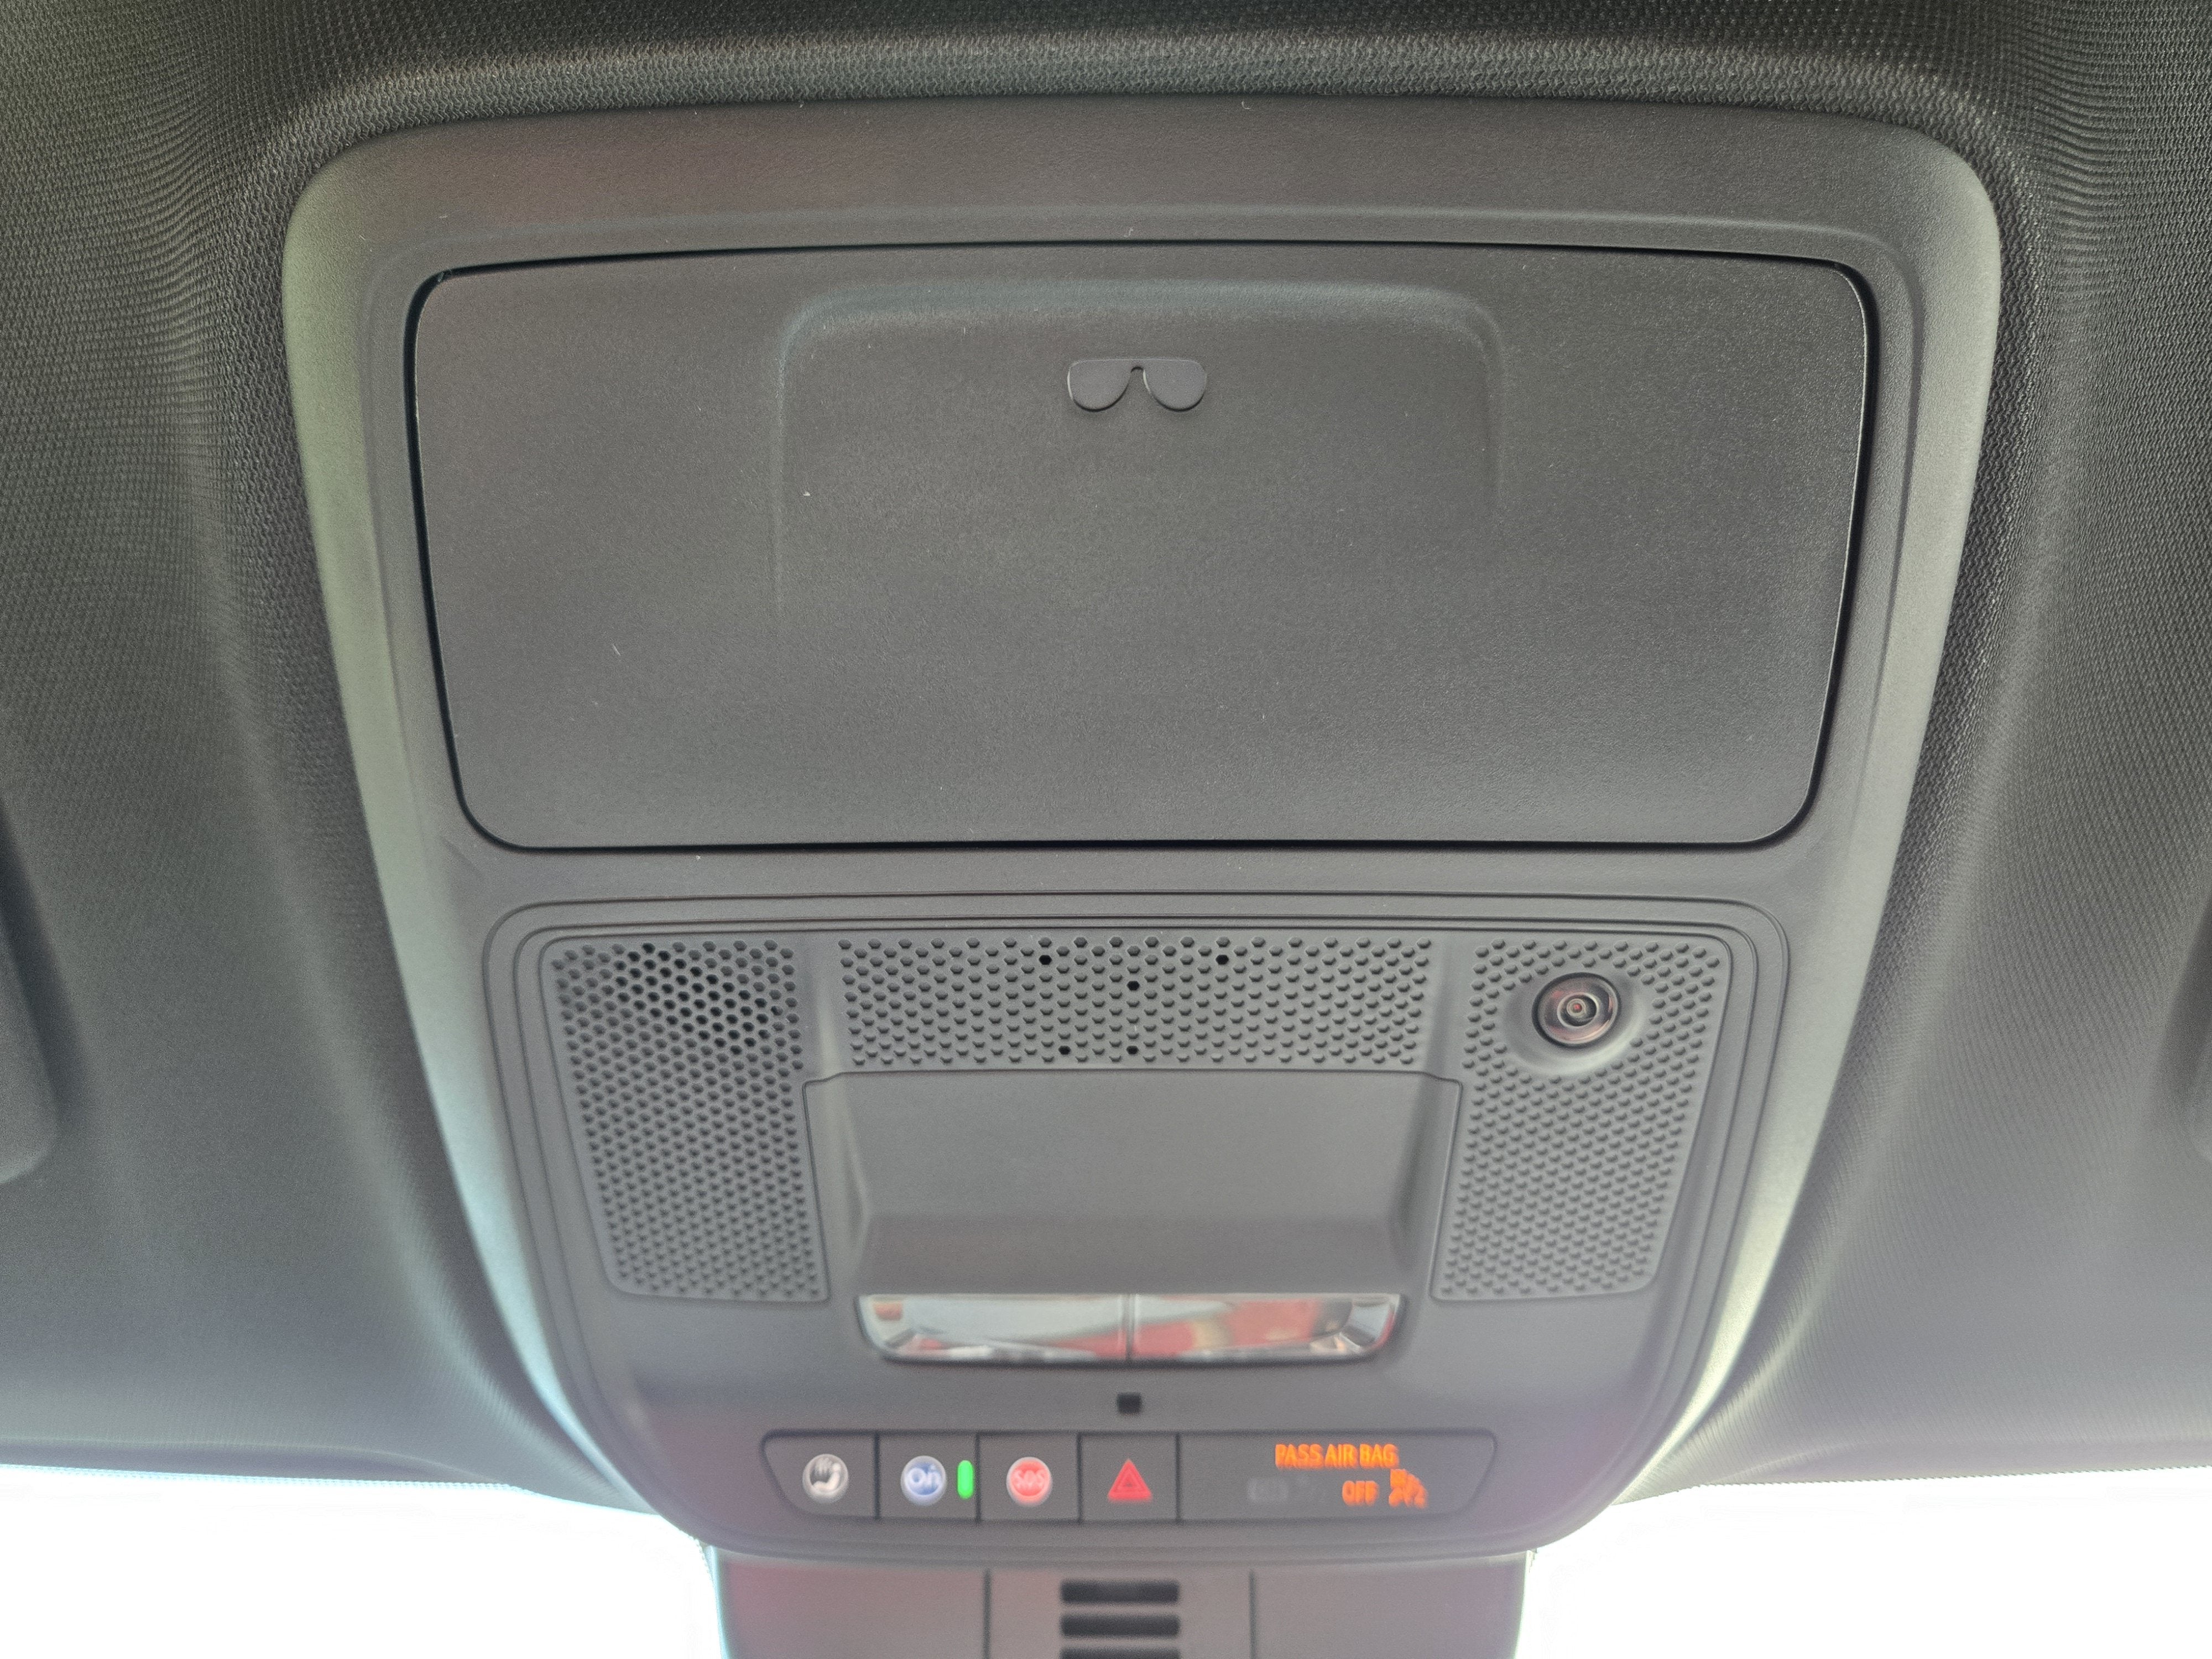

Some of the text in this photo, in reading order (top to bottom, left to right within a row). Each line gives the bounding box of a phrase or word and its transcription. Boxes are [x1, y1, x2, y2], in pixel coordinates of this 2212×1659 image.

[1275, 1444, 1399, 1469] PASS AIR BAG
[1013, 1469, 1046, 1488] SOS
[1342, 1480, 1379, 1506] OFF
